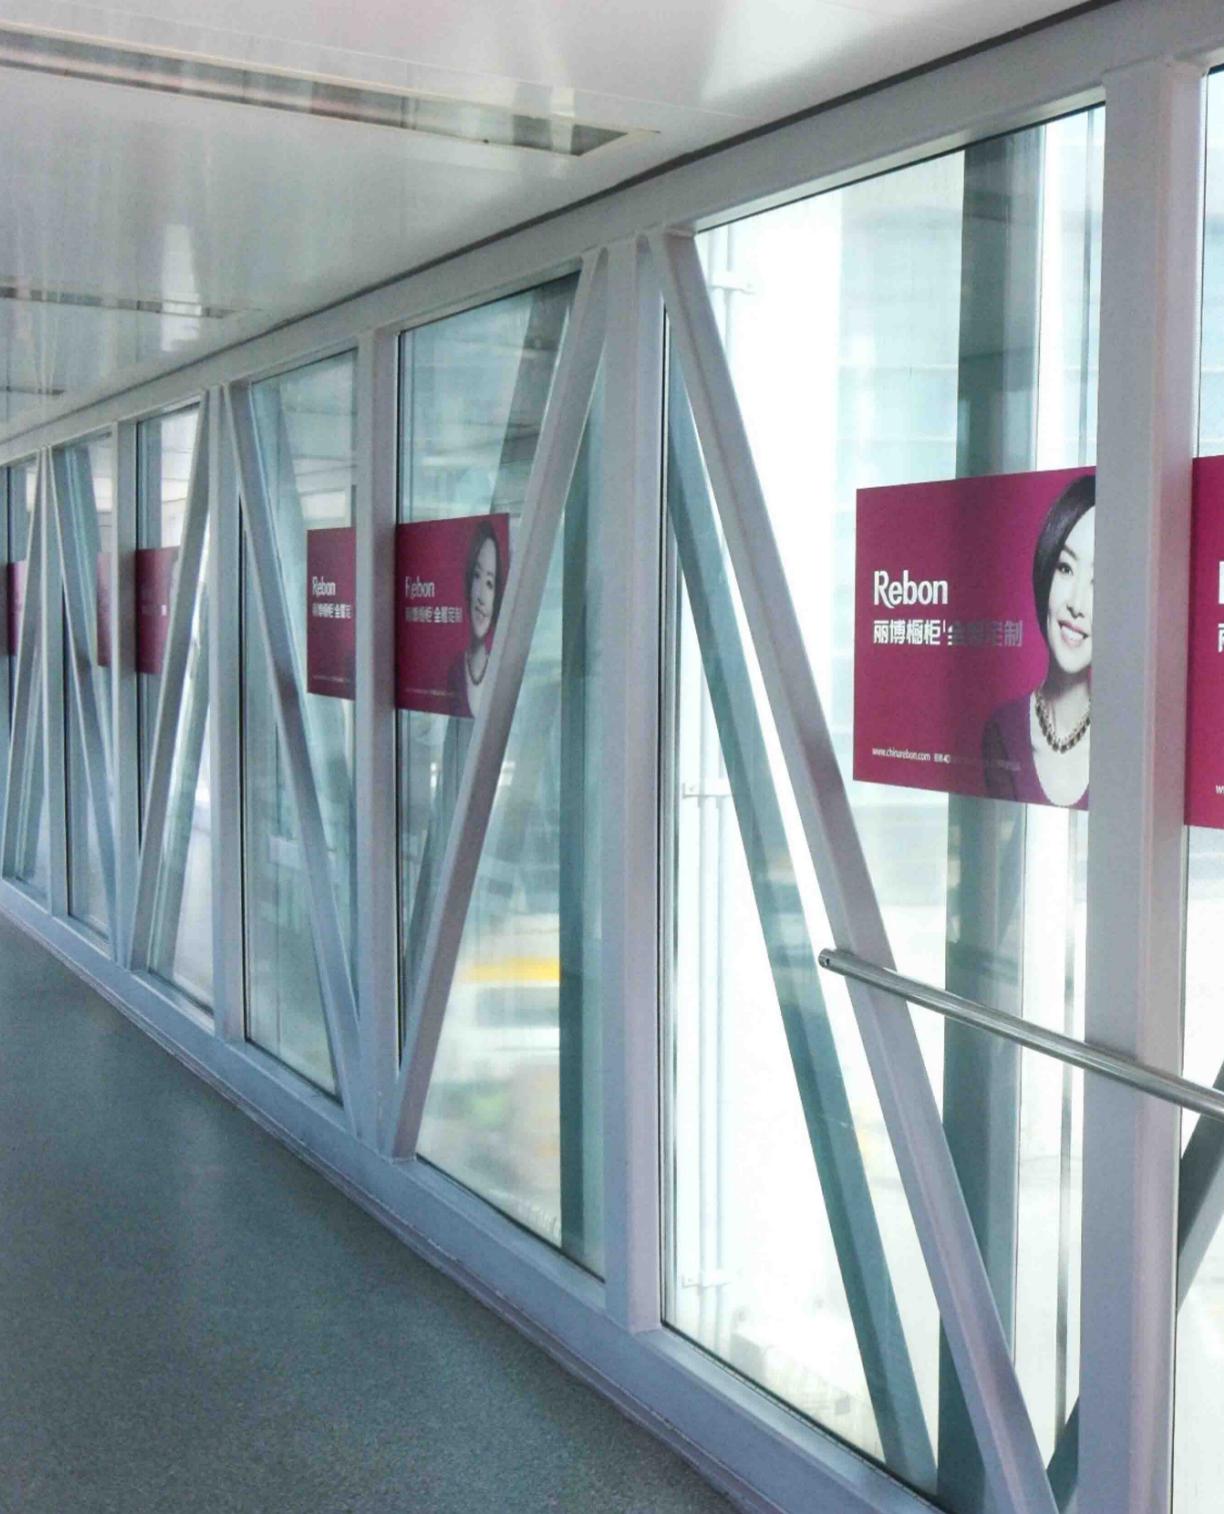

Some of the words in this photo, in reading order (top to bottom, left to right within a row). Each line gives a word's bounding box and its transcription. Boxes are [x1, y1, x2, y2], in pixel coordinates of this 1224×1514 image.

[312, 575, 336, 598] Rebon
[405, 575, 435, 600] Rebon
[873, 569, 949, 609] Rebon
[873, 618, 941, 645] 丽博橱柜
